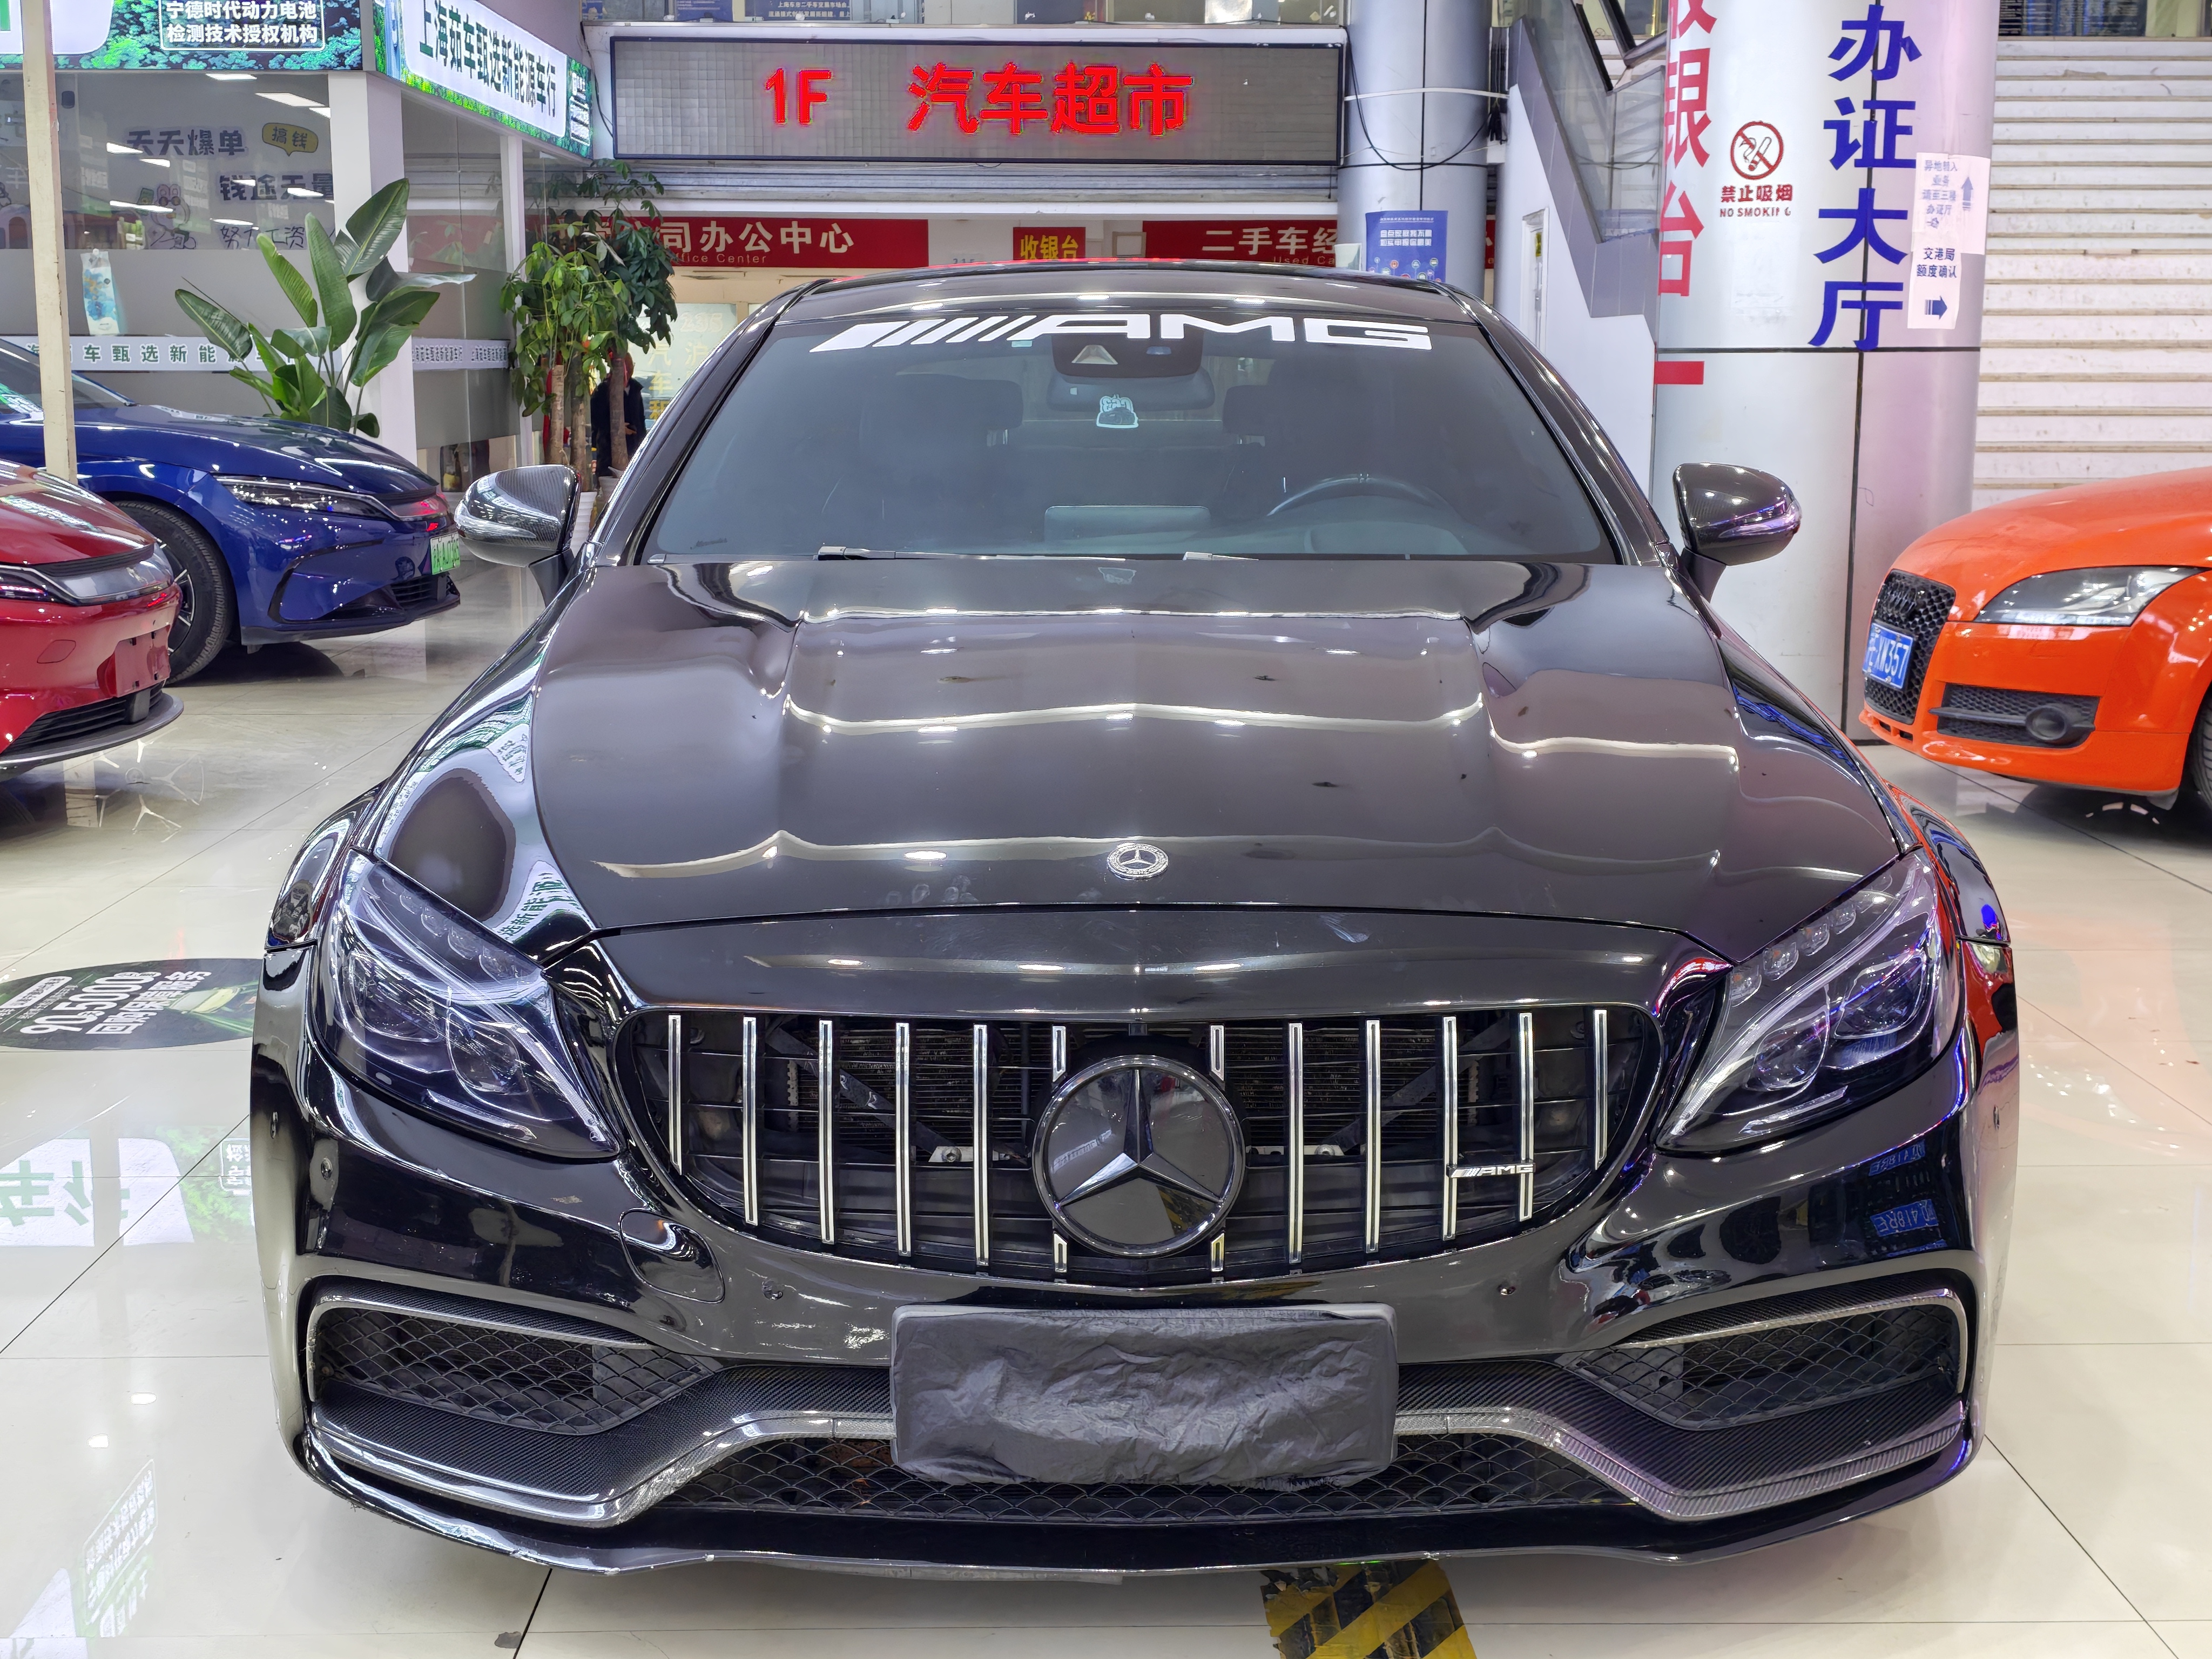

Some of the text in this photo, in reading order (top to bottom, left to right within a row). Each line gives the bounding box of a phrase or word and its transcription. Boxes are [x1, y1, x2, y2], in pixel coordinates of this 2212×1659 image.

[166, 1, 318, 19] 宁德时代动力电池
[167, 24, 318, 43] 检测技术授权机构
[765, 62, 1193, 136] 1F 汽车超市
[1808, 4, 1923, 351] 办证大厅
[1721, 184, 1793, 203] 禁止吸烟
[1719, 208, 1735, 217] NO
[1020, 234, 1079, 259] 收银台
[1923, 247, 1955, 261] 交港局
[716, 253, 767, 264] Center
[1007, 313, 1433, 350] AMG
[1476, 1164, 1534, 1177] AMG
